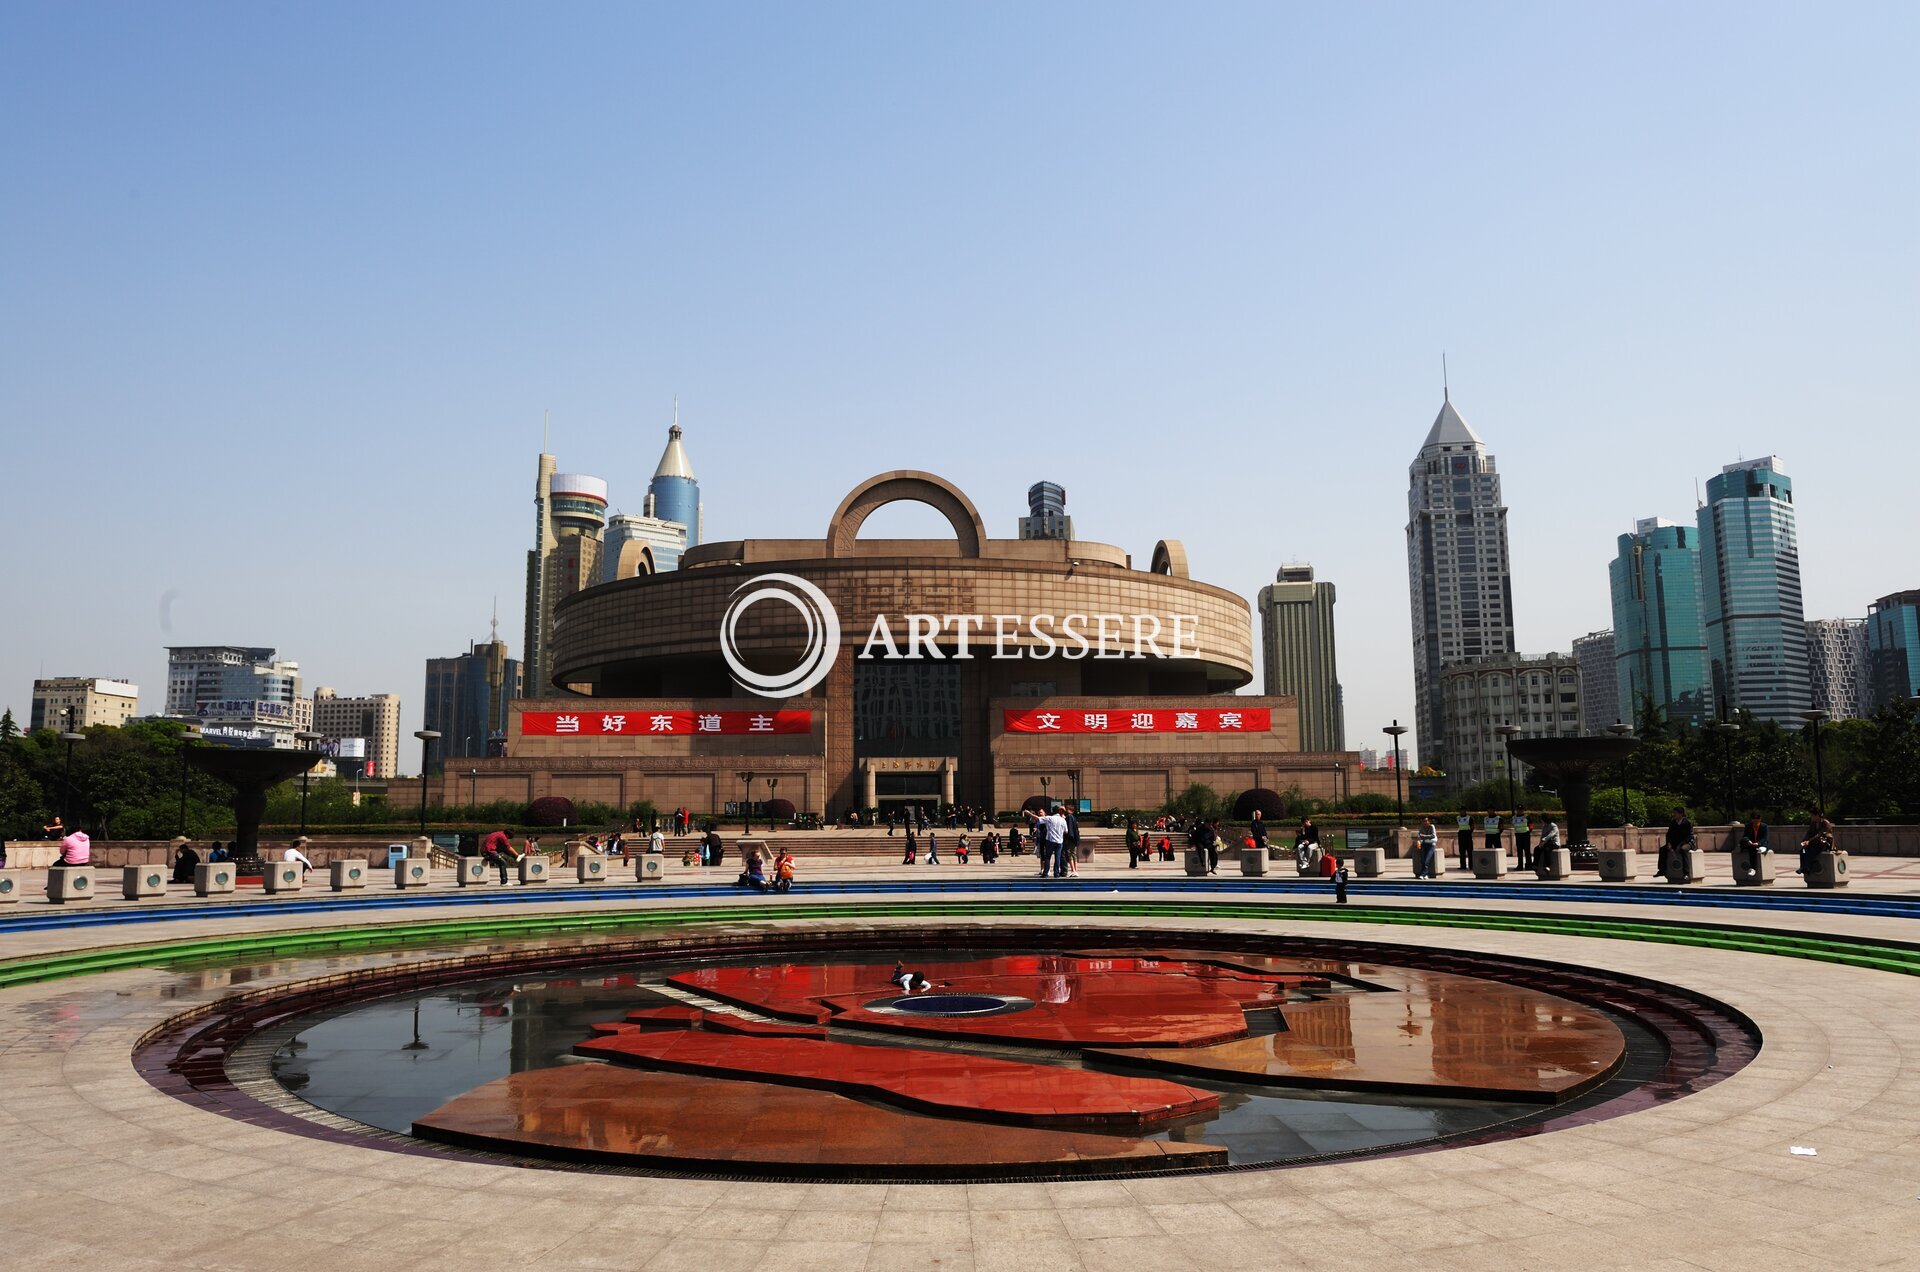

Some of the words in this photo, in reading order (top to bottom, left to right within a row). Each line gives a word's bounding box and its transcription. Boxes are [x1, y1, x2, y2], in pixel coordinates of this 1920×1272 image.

[556, 714, 774, 732] 当好东道主
[1037, 712, 1242, 729] 文明迎嘉宾
